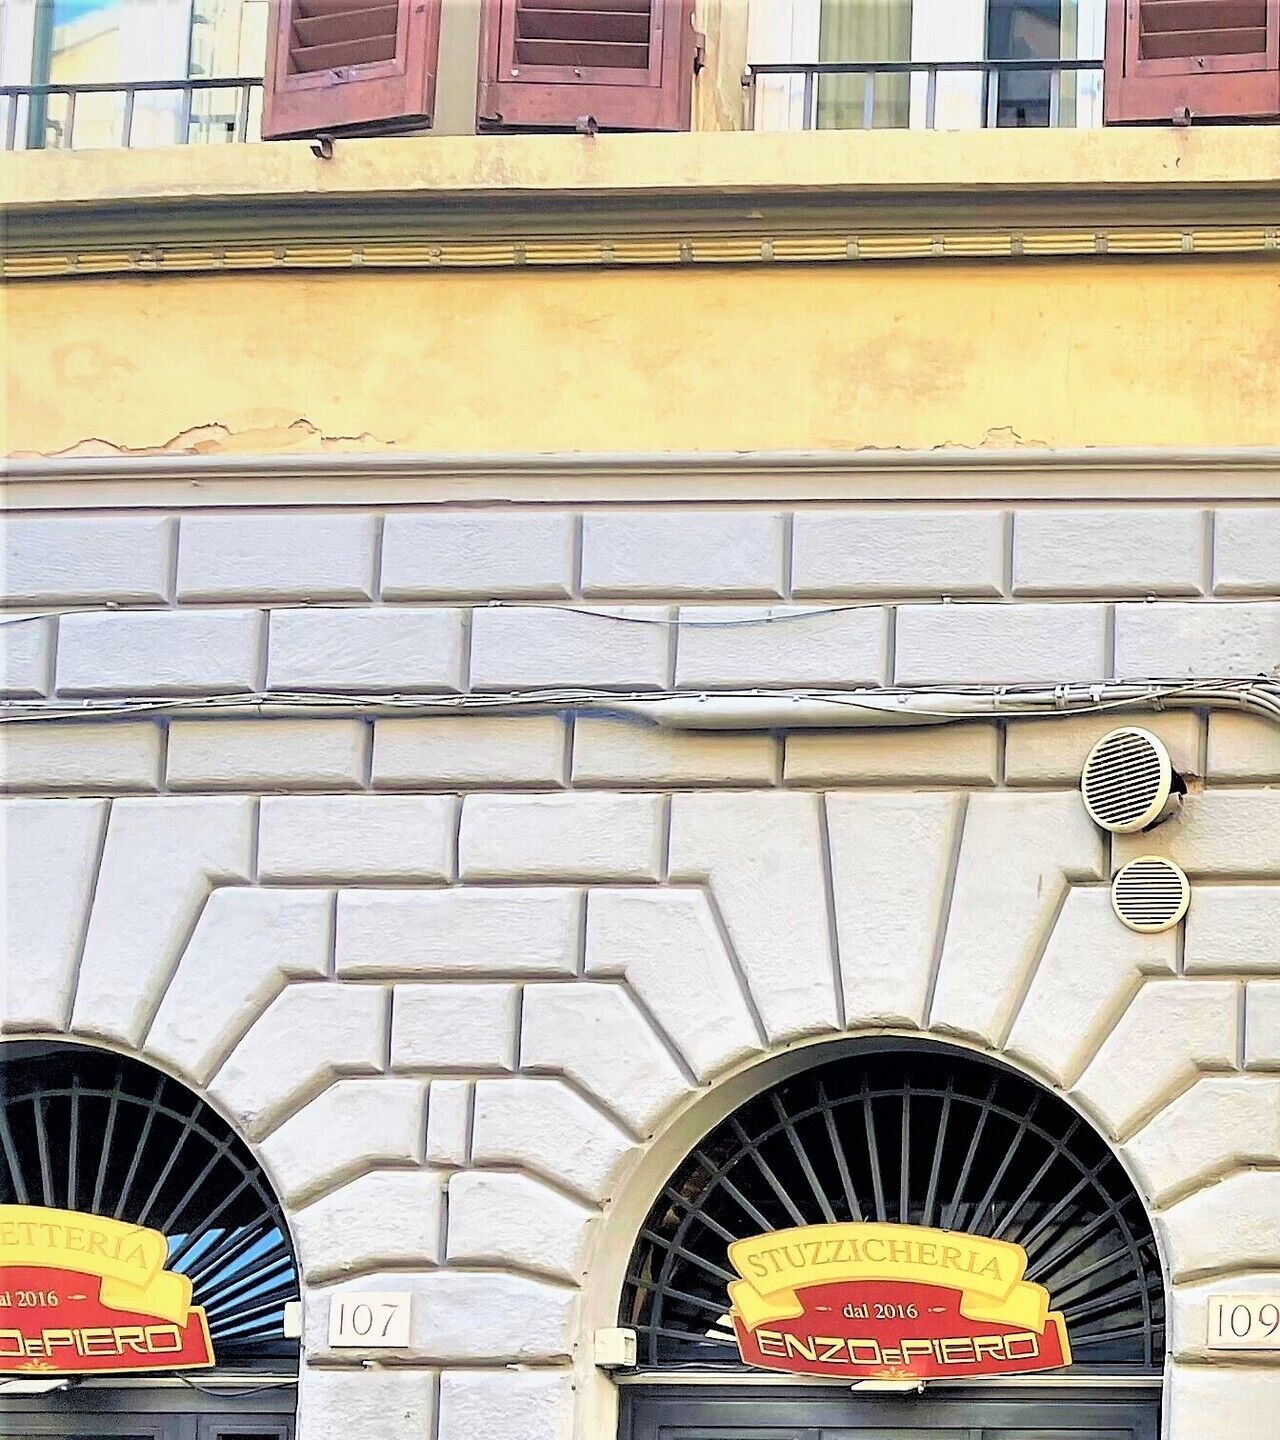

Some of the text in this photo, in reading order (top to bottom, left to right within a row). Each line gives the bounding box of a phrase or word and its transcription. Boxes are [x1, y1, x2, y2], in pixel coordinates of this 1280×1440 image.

[0, 1222, 148, 1269] ETTERIA
[748, 1238, 1003, 1280] STUZZICHERIA
[18, 1290, 59, 1307] 2016
[843, 1303, 918, 1319] dal 2016
[339, 1303, 400, 1337] 107
[1218, 1303, 1280, 1338] 109
